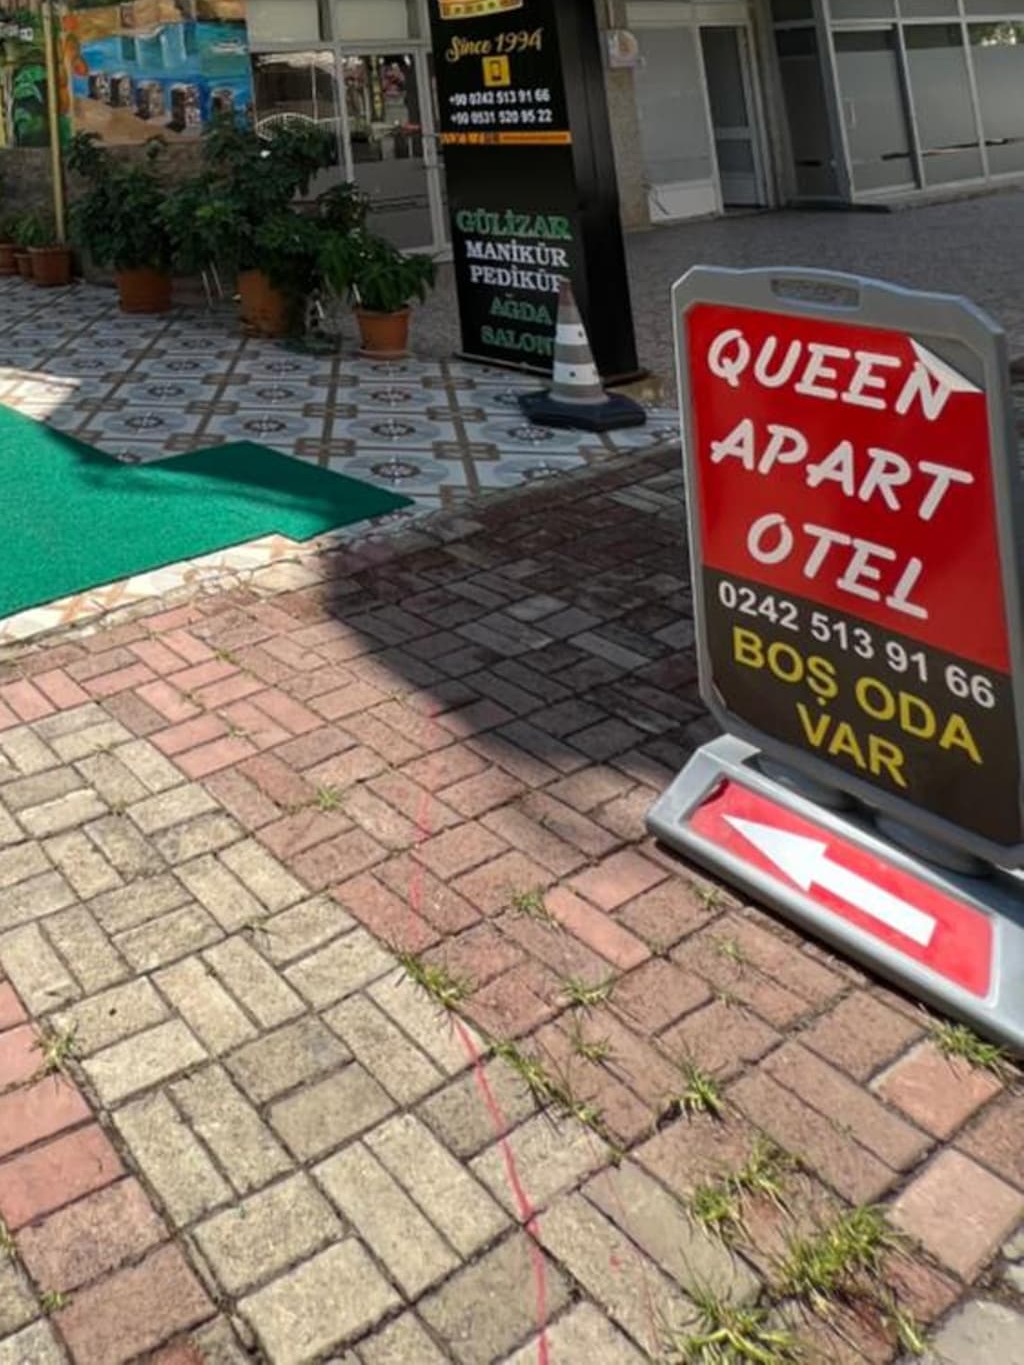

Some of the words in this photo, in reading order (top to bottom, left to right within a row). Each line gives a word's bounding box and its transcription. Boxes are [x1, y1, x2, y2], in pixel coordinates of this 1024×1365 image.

[445, 35, 491, 62] Since
[494, 26, 545, 53] 1994
[469, 91, 494, 105] 0242
[496, 90, 516, 104] 513
[518, 88, 532, 103] 91
[534, 88, 551, 102] 66
[537, 108, 553, 123] 22
[456, 207, 573, 241] GÜLİZAR
[464, 239, 569, 267] MANİKÜR
[490, 292, 553, 325] AĞDA
[480, 325, 554, 355] SALON
[707, 327, 954, 421] QUEEN
[710, 418, 976, 522] APART
[746, 512, 928, 620] OTEL
[717, 580, 800, 632] 0242
[811, 610, 875, 660] 513
[886, 640, 929, 682] 91
[944, 663, 996, 709] 66
[732, 626, 839, 708] BOŞ
[854, 676, 984, 765] ODA
[795, 701, 909, 788] VAR
